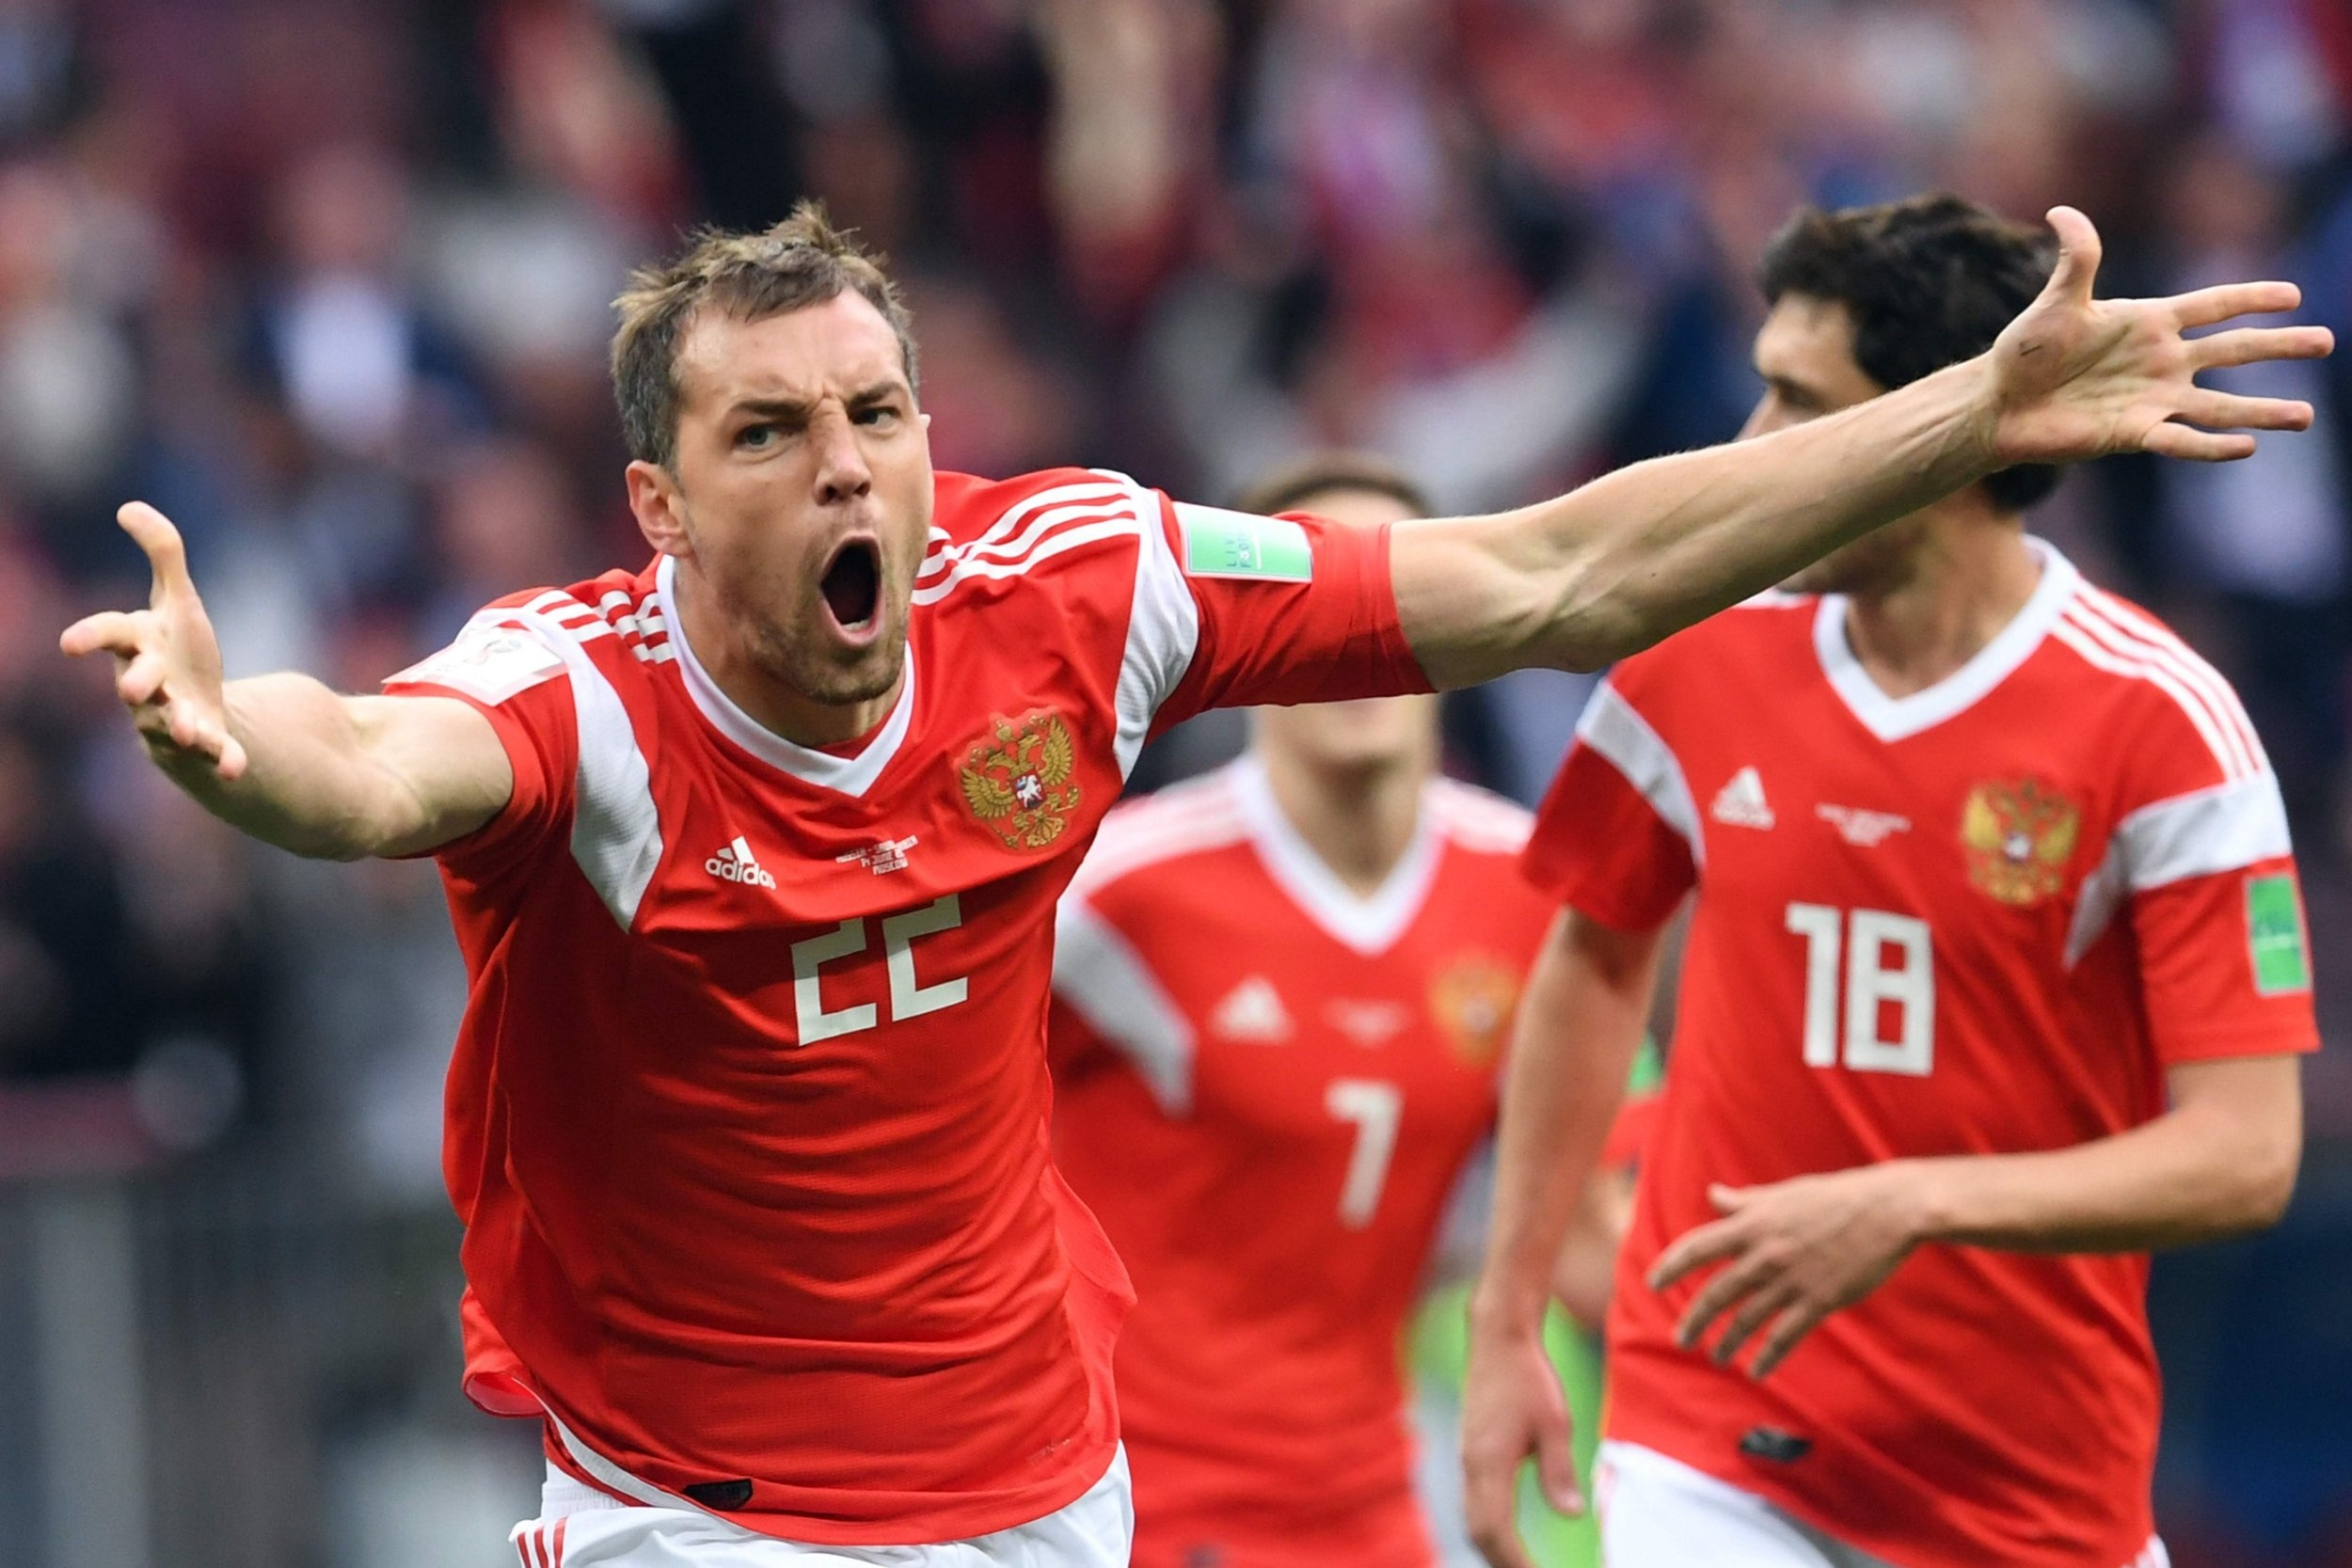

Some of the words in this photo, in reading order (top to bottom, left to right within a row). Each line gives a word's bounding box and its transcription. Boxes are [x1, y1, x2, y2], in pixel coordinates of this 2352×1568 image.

[790, 893, 968, 1047] 22
[1786, 900, 1936, 1077] 18
[1323, 1078, 1405, 1231] 7
